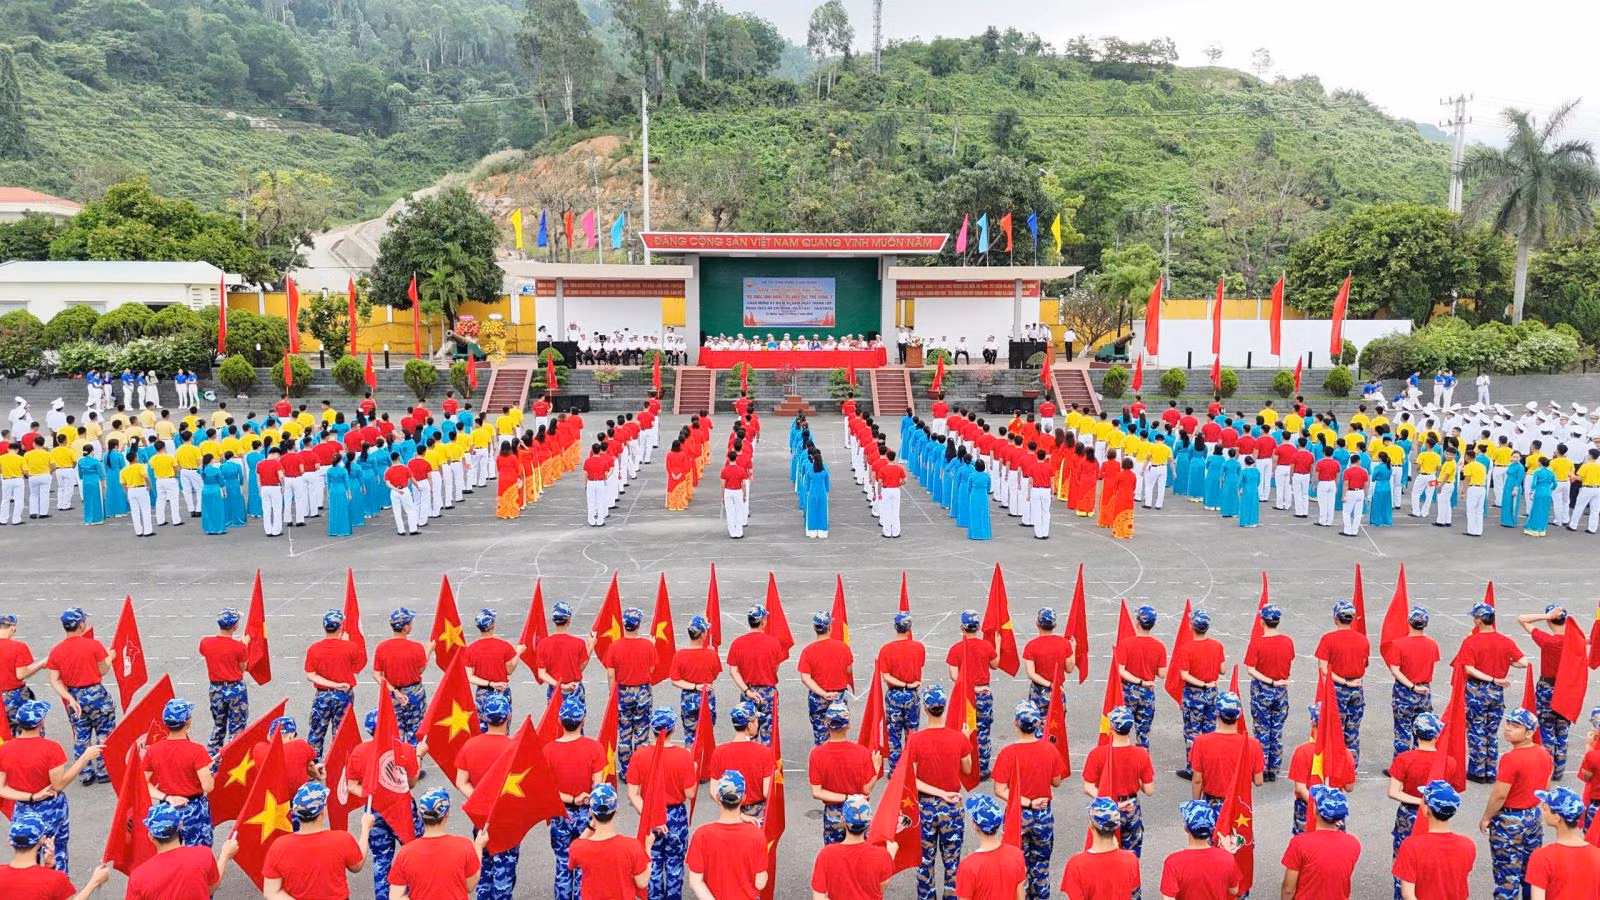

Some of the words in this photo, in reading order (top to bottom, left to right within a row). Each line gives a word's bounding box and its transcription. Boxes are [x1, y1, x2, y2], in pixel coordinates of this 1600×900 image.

[774, 238, 799, 247] NAM
[802, 238, 841, 247] QUANG
[845, 238, 869, 248] VINH
[872, 236, 904, 248] MUÔN
[907, 236, 932, 247] NĂM
